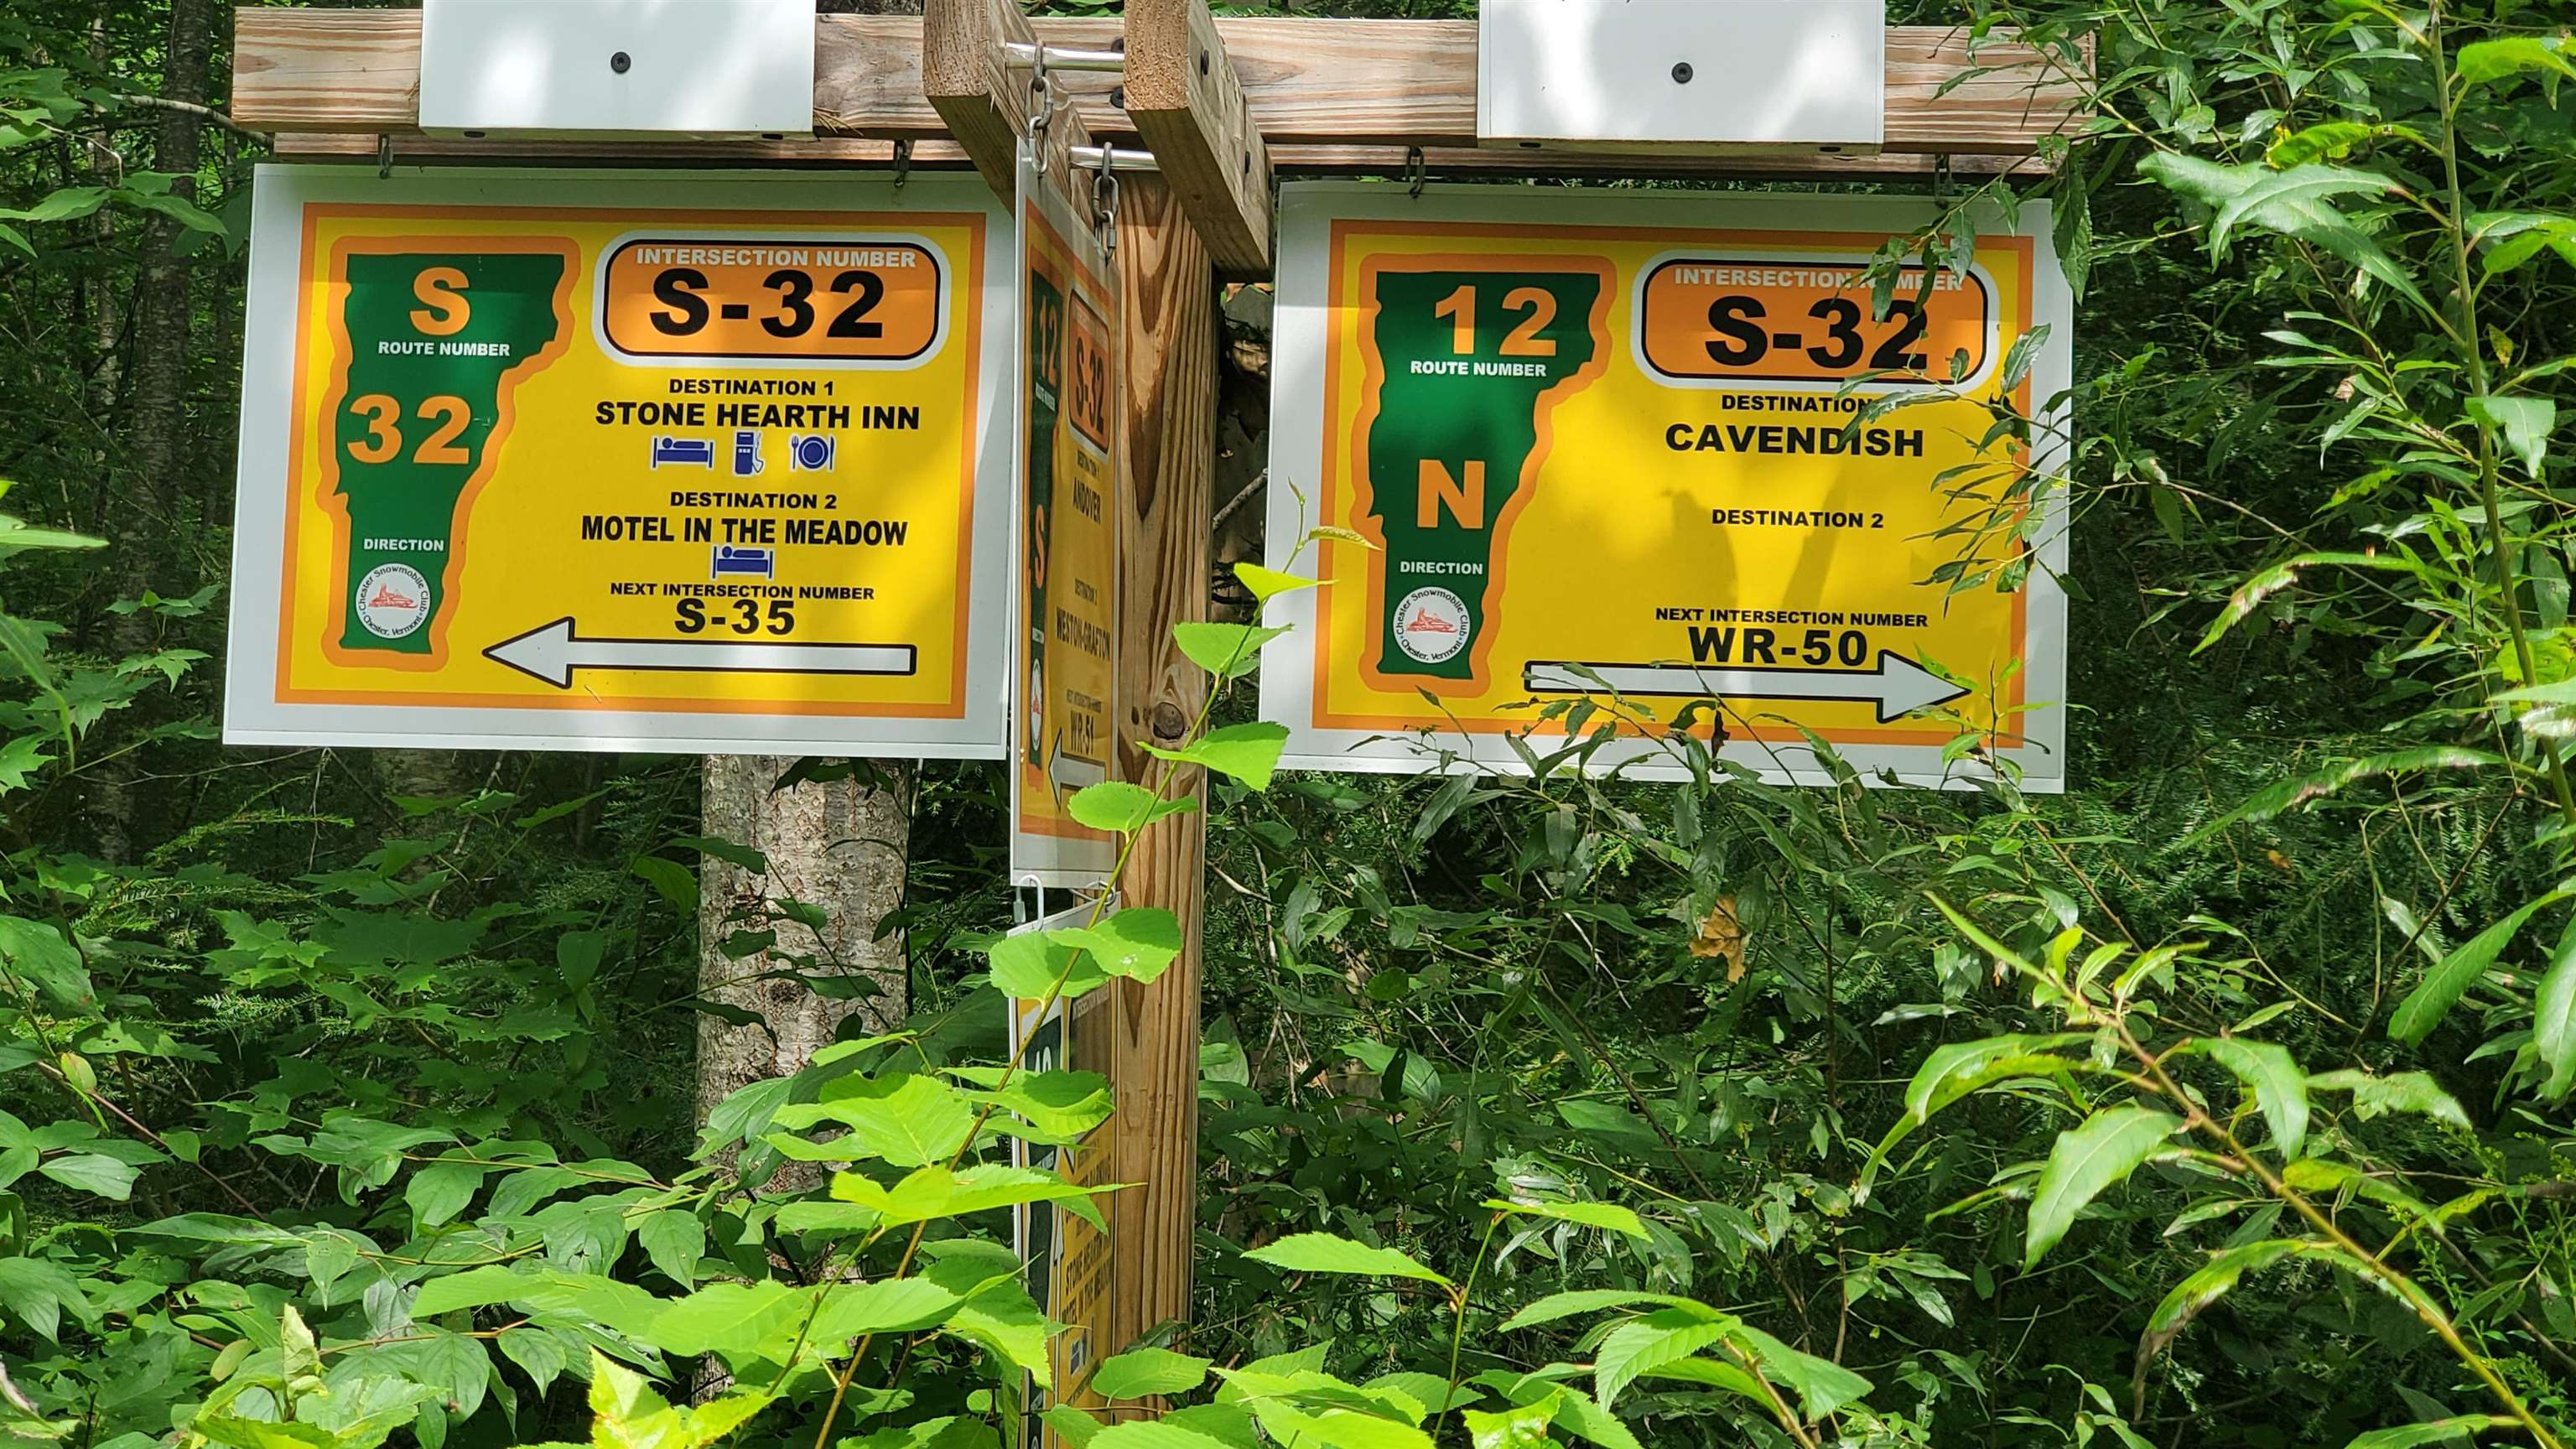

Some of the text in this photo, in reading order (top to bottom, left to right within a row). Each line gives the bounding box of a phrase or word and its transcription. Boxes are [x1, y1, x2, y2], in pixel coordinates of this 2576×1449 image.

[636, 248, 916, 268] INTERSECTION NUMBER
[1675, 268, 1852, 288] INTERSECTION
[409, 267, 470, 335] S
[649, 267, 885, 339] S-32
[1435, 285, 1557, 356] 12
[1705, 295, 1929, 370] S-32
[378, 340, 511, 356] ROUTE NUMBER
[1410, 361, 1547, 377] ROUTE NUMBER
[669, 378, 834, 397] DESTINATION 1
[1076, 336, 1104, 436] S-32
[346, 393, 471, 465] 32
[595, 401, 920, 430] STONE HEARTH INN
[1665, 423, 1924, 457] CAVENDISH
[670, 491, 837, 510] DESTINATION 2
[1417, 459, 1485, 529] N
[581, 515, 908, 547] MOTEL IN THE MEADOW
[1711, 509, 1884, 529] DESTINATION 2
[363, 538, 444, 552] DIRECTION
[1400, 561, 1483, 575] DIRECTION
[358, 566, 428, 613] Chester Snowmobile Club
[610, 582, 875, 600] NEXT INTERSECTION NUMBER
[392, 615, 423, 636] Vermont
[674, 598, 795, 636] S-35
[1395, 589, 1468, 637] Chester Snowmobile Club
[1655, 608, 1929, 628] NEXT INTERSECTION NUMBER
[1431, 640, 1463, 661] Vermont
[1688, 626, 1867, 667] WR-50
